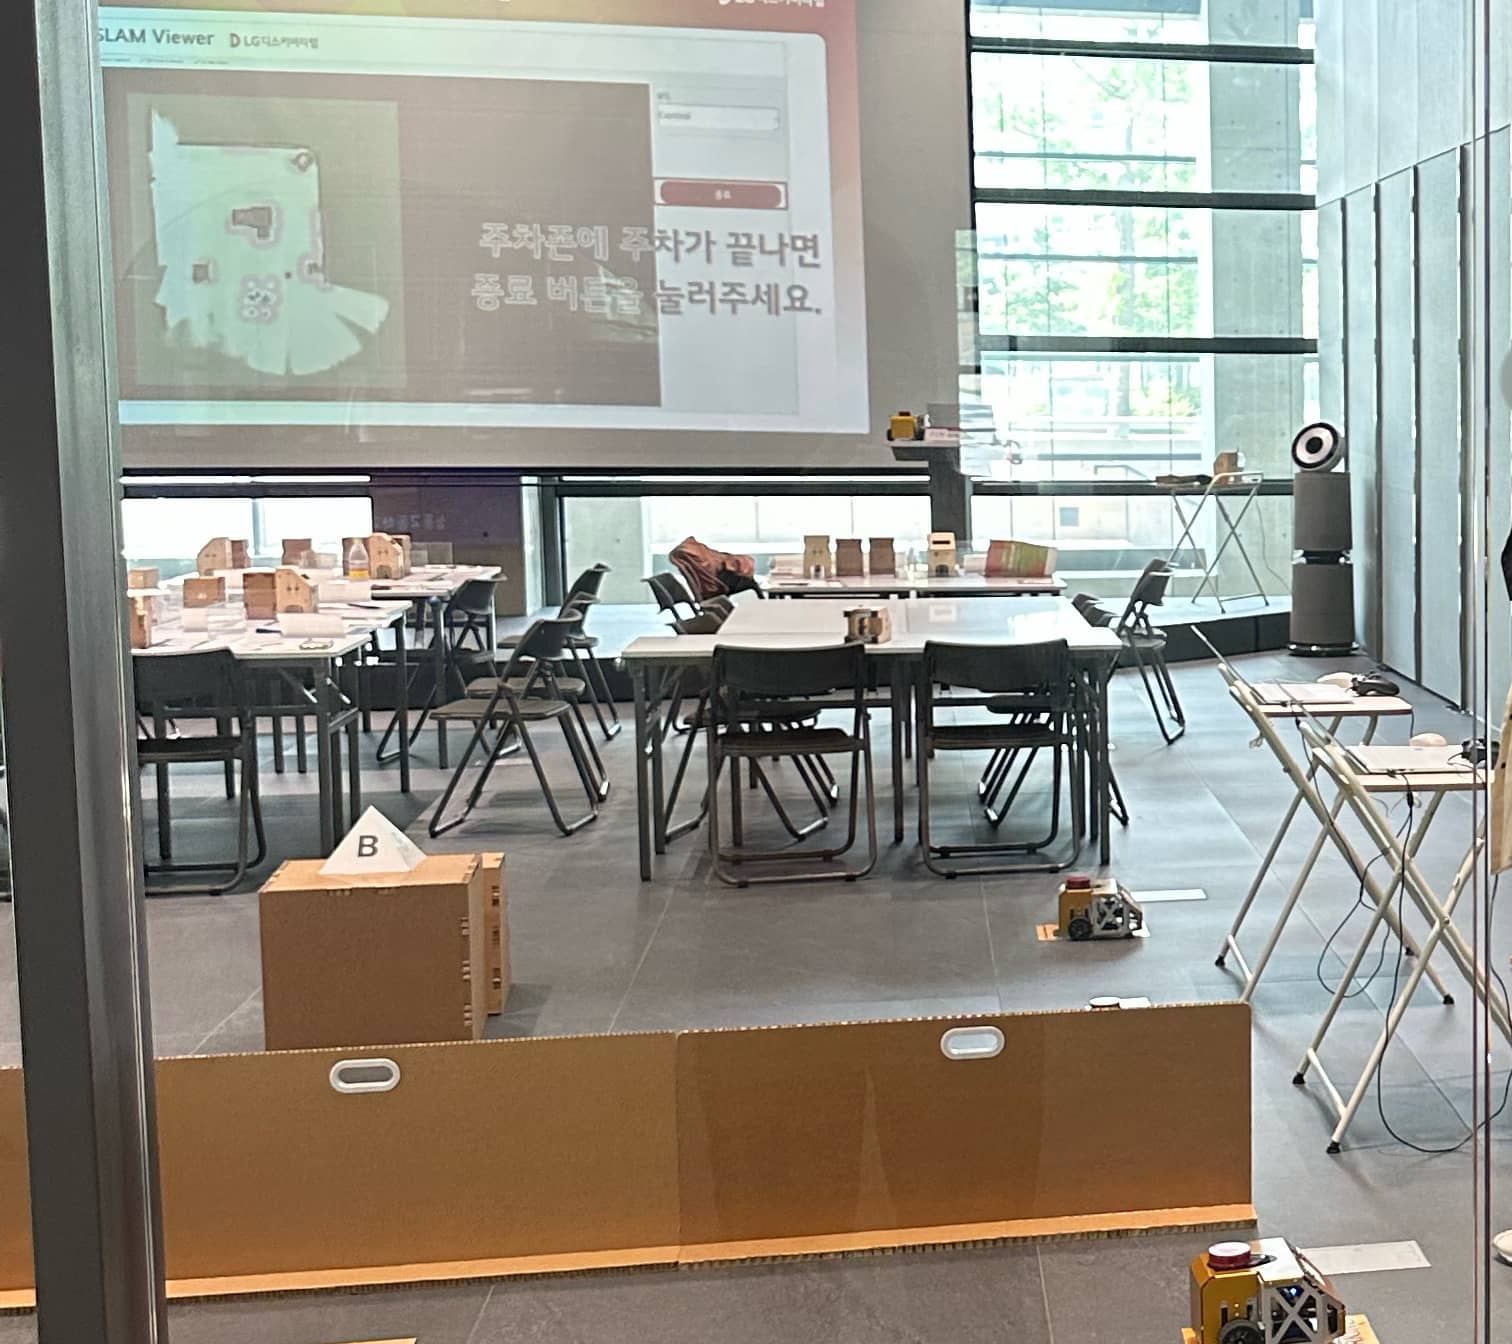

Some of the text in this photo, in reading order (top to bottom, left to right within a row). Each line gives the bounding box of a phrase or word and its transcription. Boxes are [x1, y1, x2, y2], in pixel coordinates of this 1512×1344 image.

[98, 27, 215, 46] SLAM Viewer
[618, 225, 717, 264] 주차가
[726, 230, 823, 269] 끝나면
[471, 272, 823, 318] 종료 버튼을 눌러주세요.
[357, 834, 379, 858] B
